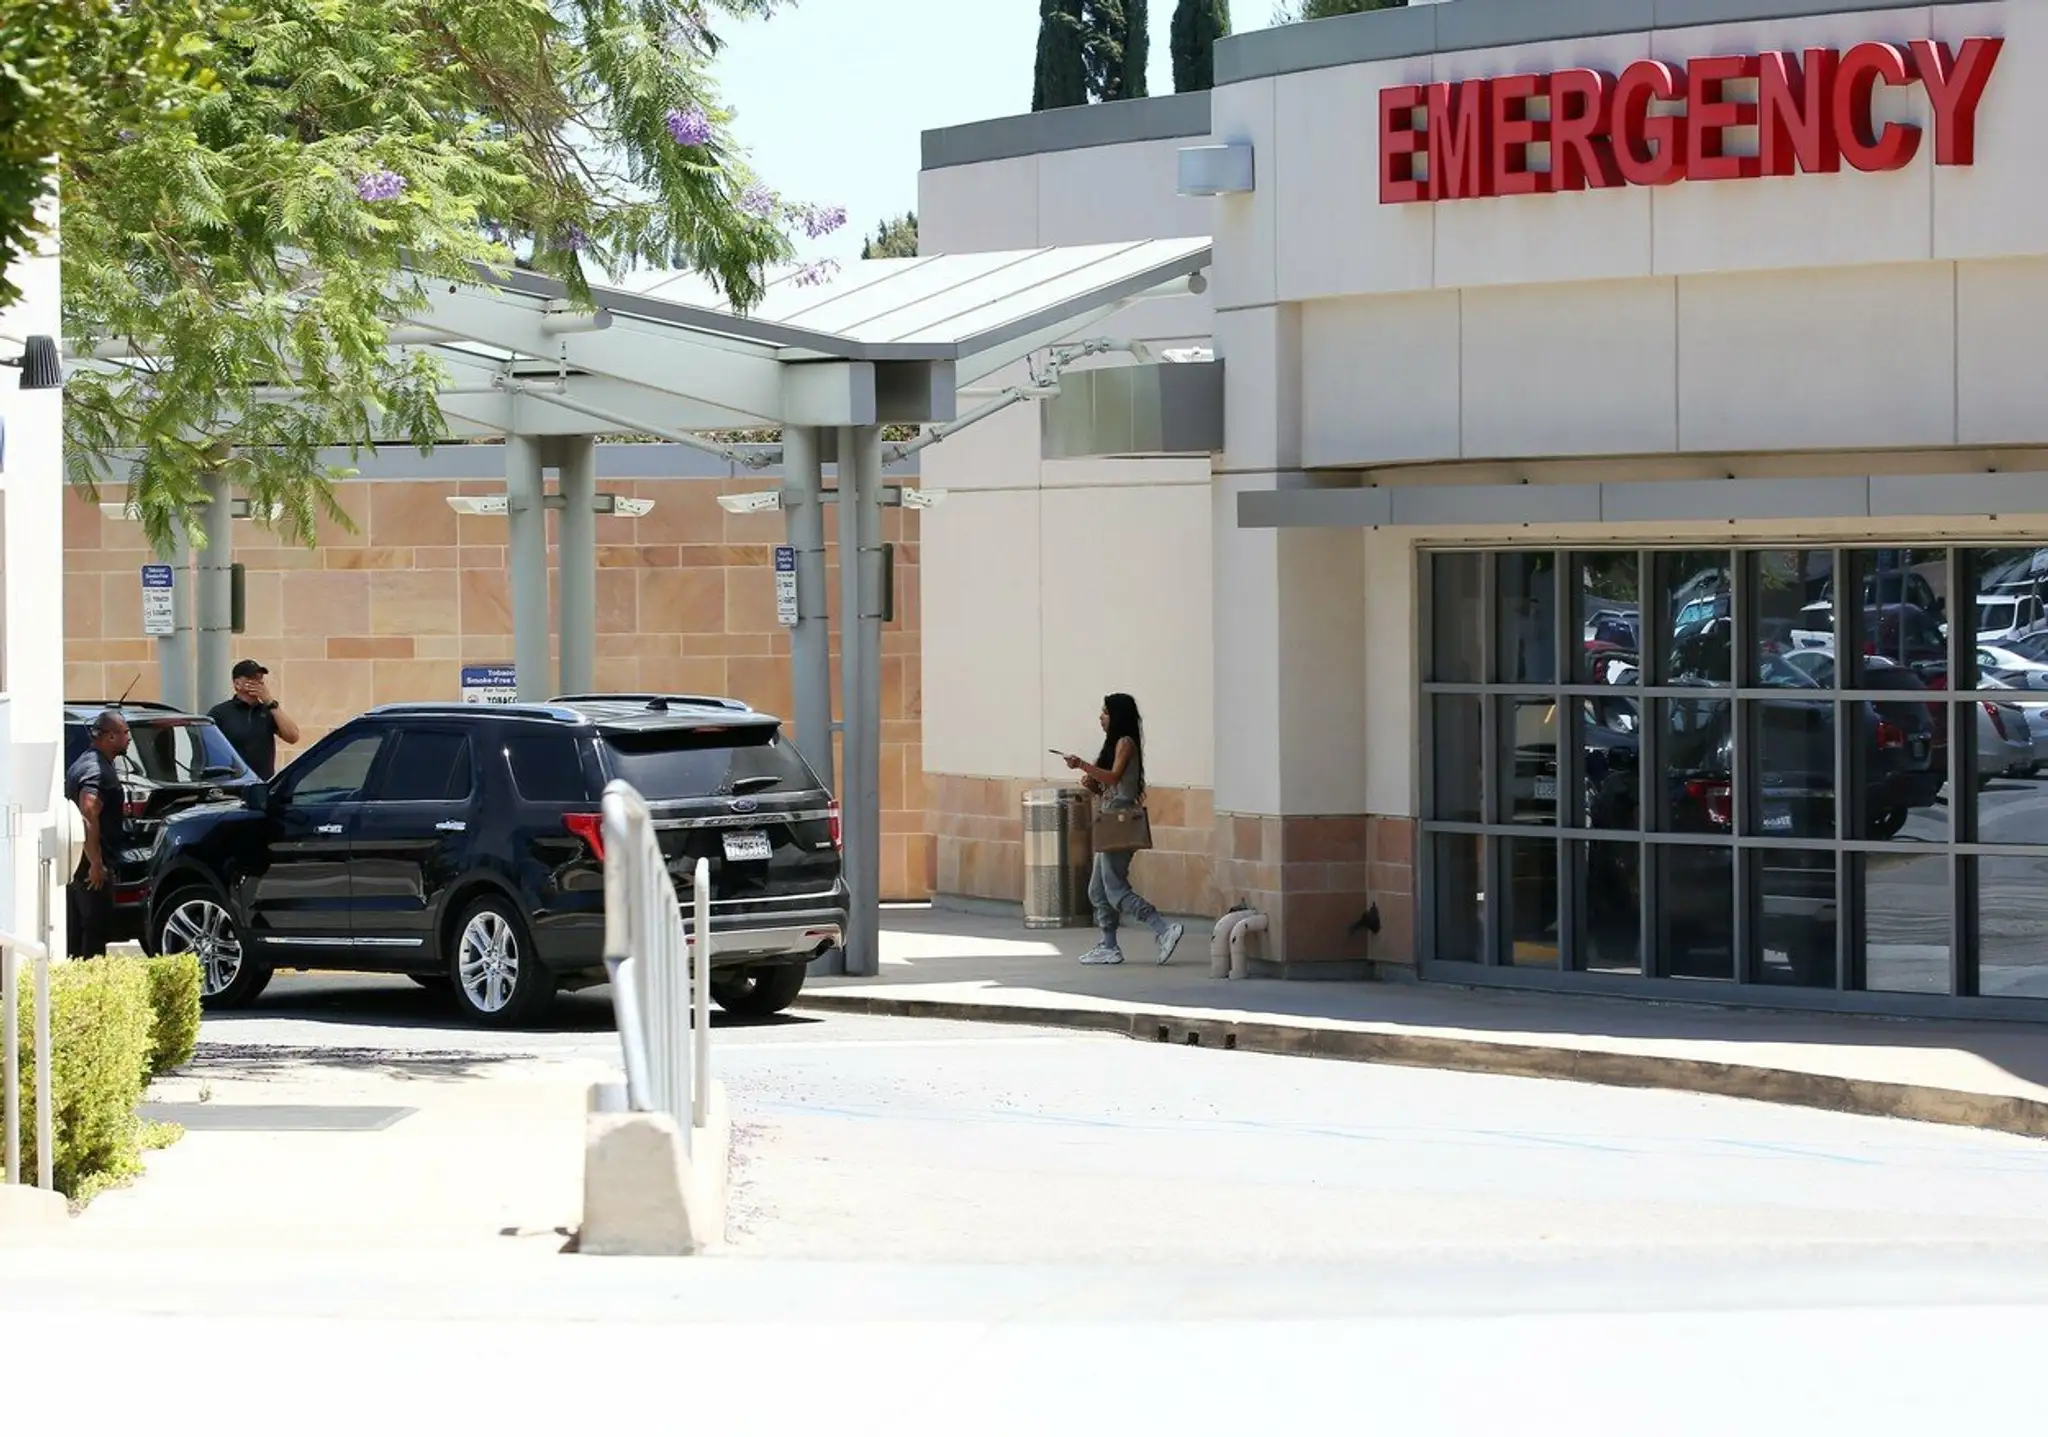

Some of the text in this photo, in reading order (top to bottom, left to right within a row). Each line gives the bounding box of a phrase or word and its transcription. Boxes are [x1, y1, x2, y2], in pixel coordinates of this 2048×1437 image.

[1379, 37, 2003, 204] EMERGENCY
[466, 676, 511, 684] Smoke-Free
[487, 696, 517, 704] TOBACC
